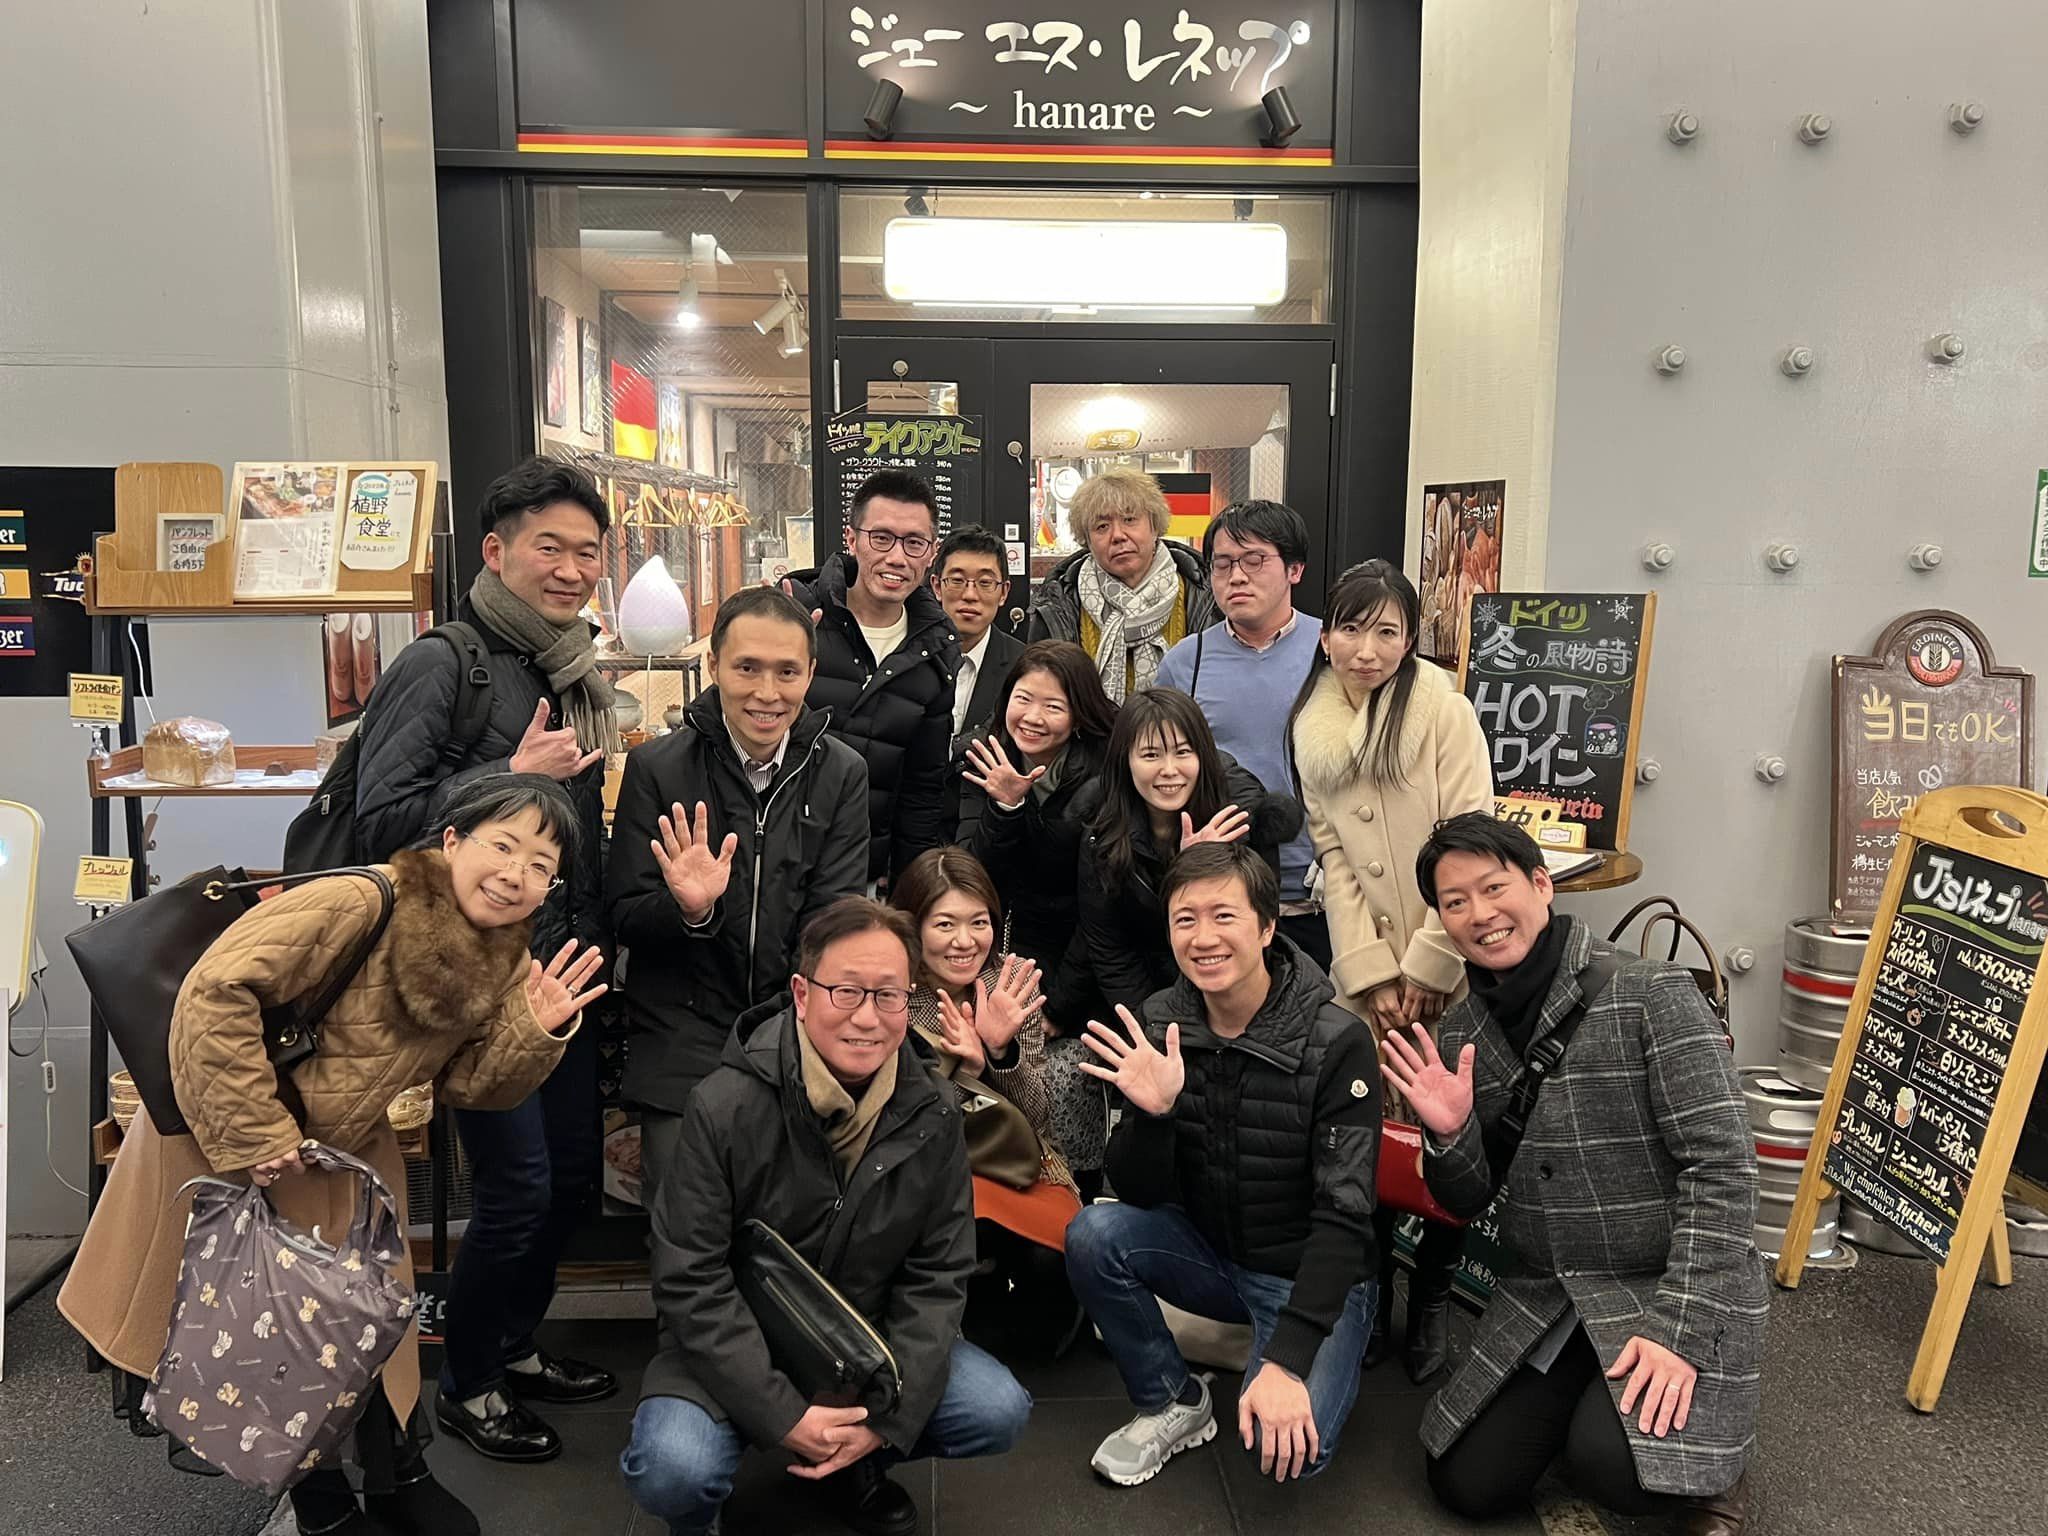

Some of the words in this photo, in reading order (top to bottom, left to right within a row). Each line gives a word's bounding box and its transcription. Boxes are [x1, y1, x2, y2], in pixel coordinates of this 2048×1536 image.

[850, 7, 964, 67] ジェー
[1013, 90, 1155, 131] hanare
[864, 420, 981, 456] テイクアウト
[1510, 600, 1588, 630] ドイツ
[1479, 625, 1633, 675] 冬の風物詩
[1911, 632, 1960, 655] ERDINGER
[1474, 682, 1588, 734] HOT
[1494, 733, 1596, 786] ワイン
[1856, 768, 1902, 785] 当店人気
[1865, 1013, 1905, 1048] カマンベール
[1865, 1039, 1903, 1070] チーズフライ
[1940, 1050, 1999, 1094] 白ソーセージ
[1852, 1062, 1883, 1092] ニシンの
[1840, 1108, 1886, 1154] プレッツェル
